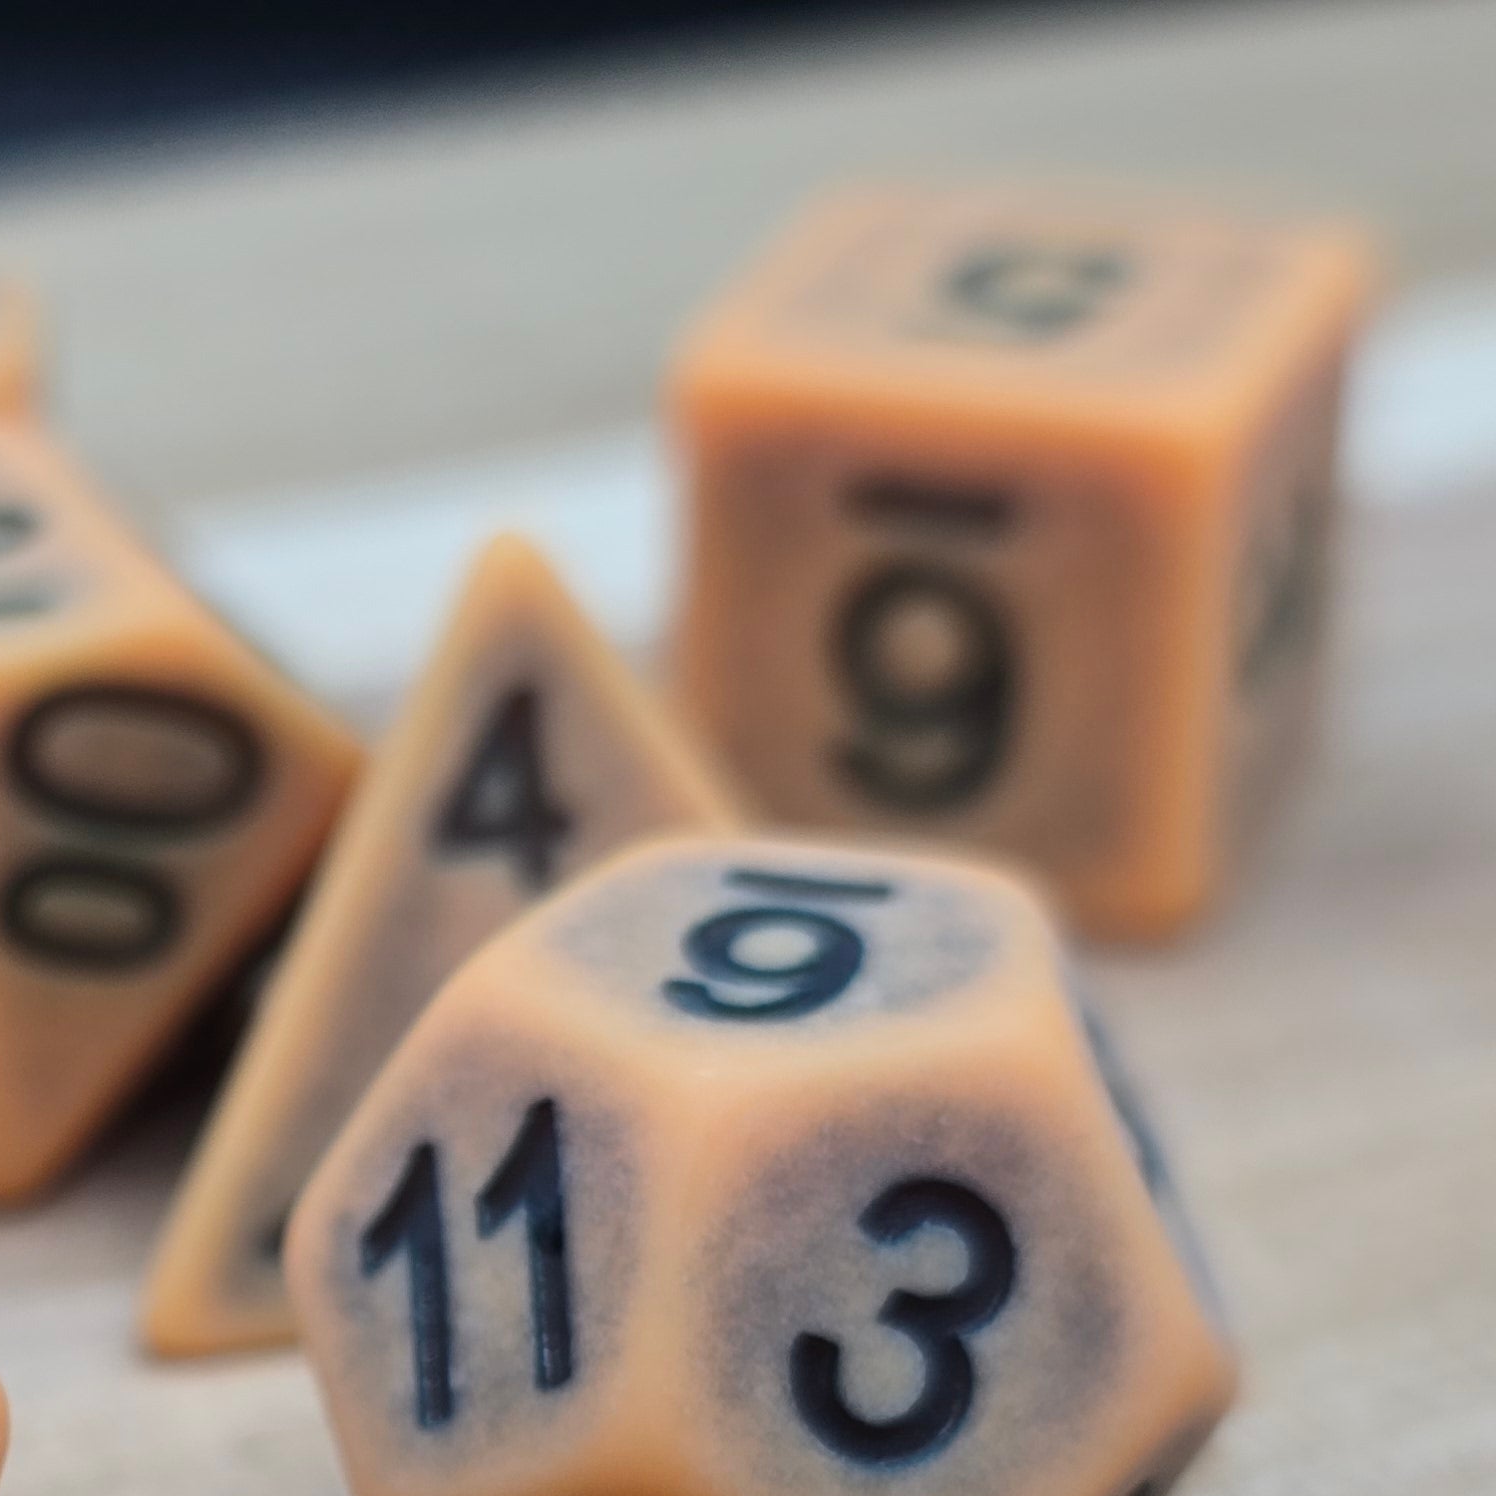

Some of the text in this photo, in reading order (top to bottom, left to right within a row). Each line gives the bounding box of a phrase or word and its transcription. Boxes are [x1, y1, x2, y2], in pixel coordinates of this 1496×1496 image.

[436, 684, 570, 888] 4
[360, 1097, 576, 1432] 11
[789, 1176, 1016, 1470] 3
